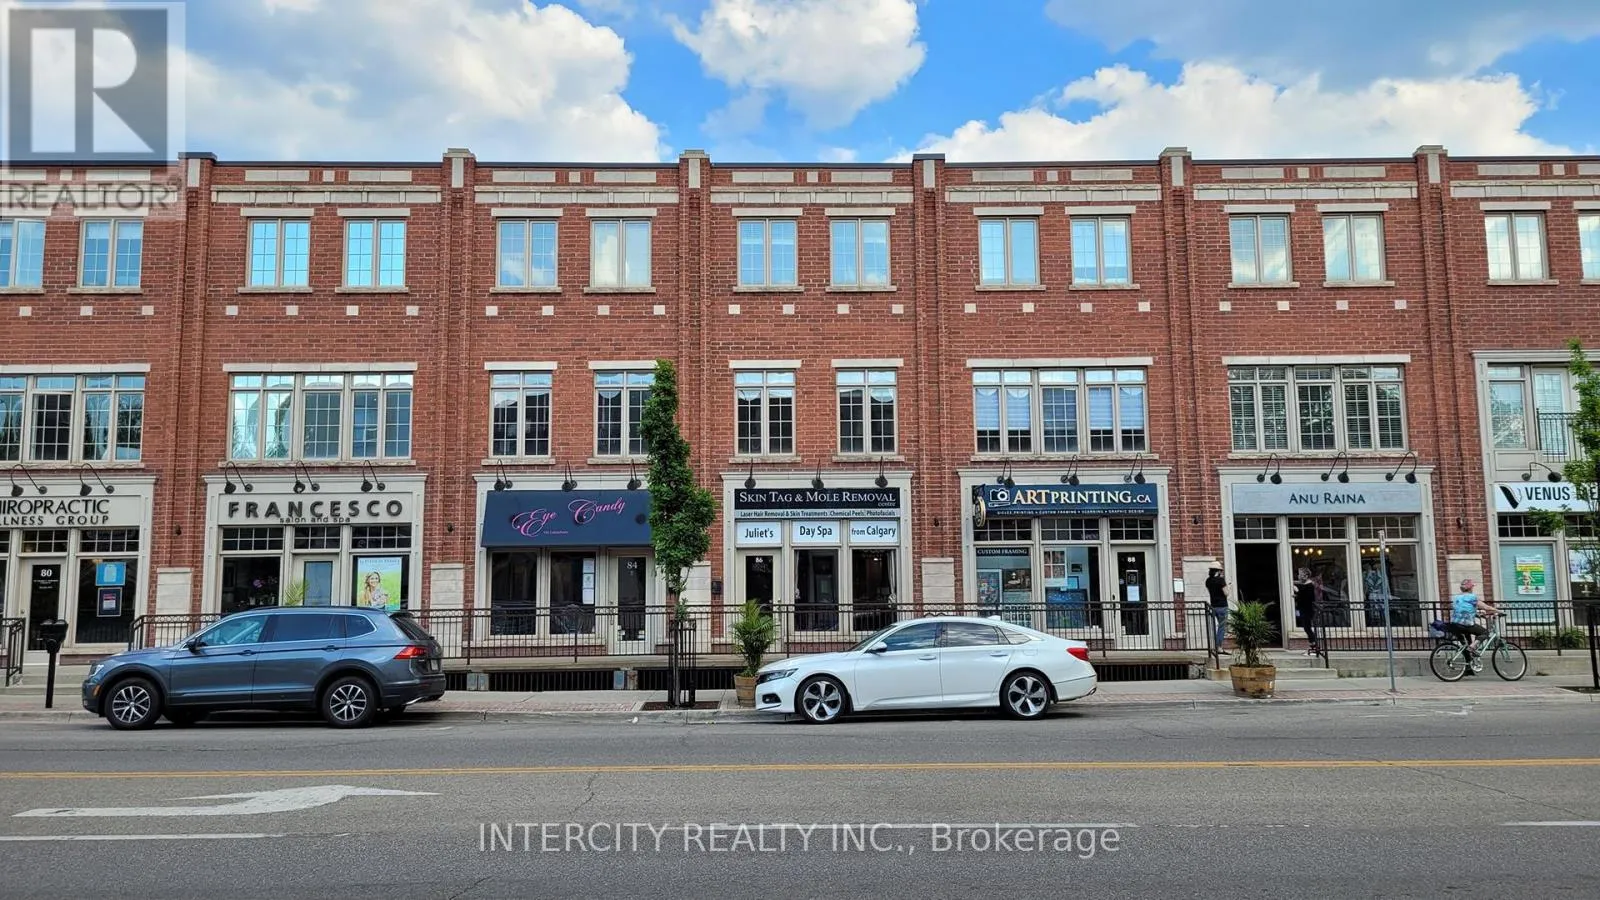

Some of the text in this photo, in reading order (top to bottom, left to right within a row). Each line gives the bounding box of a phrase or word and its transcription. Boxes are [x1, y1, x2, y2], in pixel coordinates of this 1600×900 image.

[740, 491, 896, 502] SKIN TAG & MOLE REMOVAL
[1289, 492, 1366, 505] ANU RAINA
[1524, 486, 1571, 501] VENUS
[0, 499, 110, 514] IROPRACTIC
[228, 500, 403, 518] FRANCESCO
[280, 515, 351, 524] salon and spa
[512, 497, 626, 537] Eye Candy
[764, 510, 785, 518] Removal
[0, 515, 109, 526] LNESS GROUP
[745, 527, 774, 538] Juliet's
[800, 525, 833, 538] Day Spa
[851, 525, 896, 538] from Calgary
[626, 561, 638, 569] 84
[40, 569, 53, 577] 80
